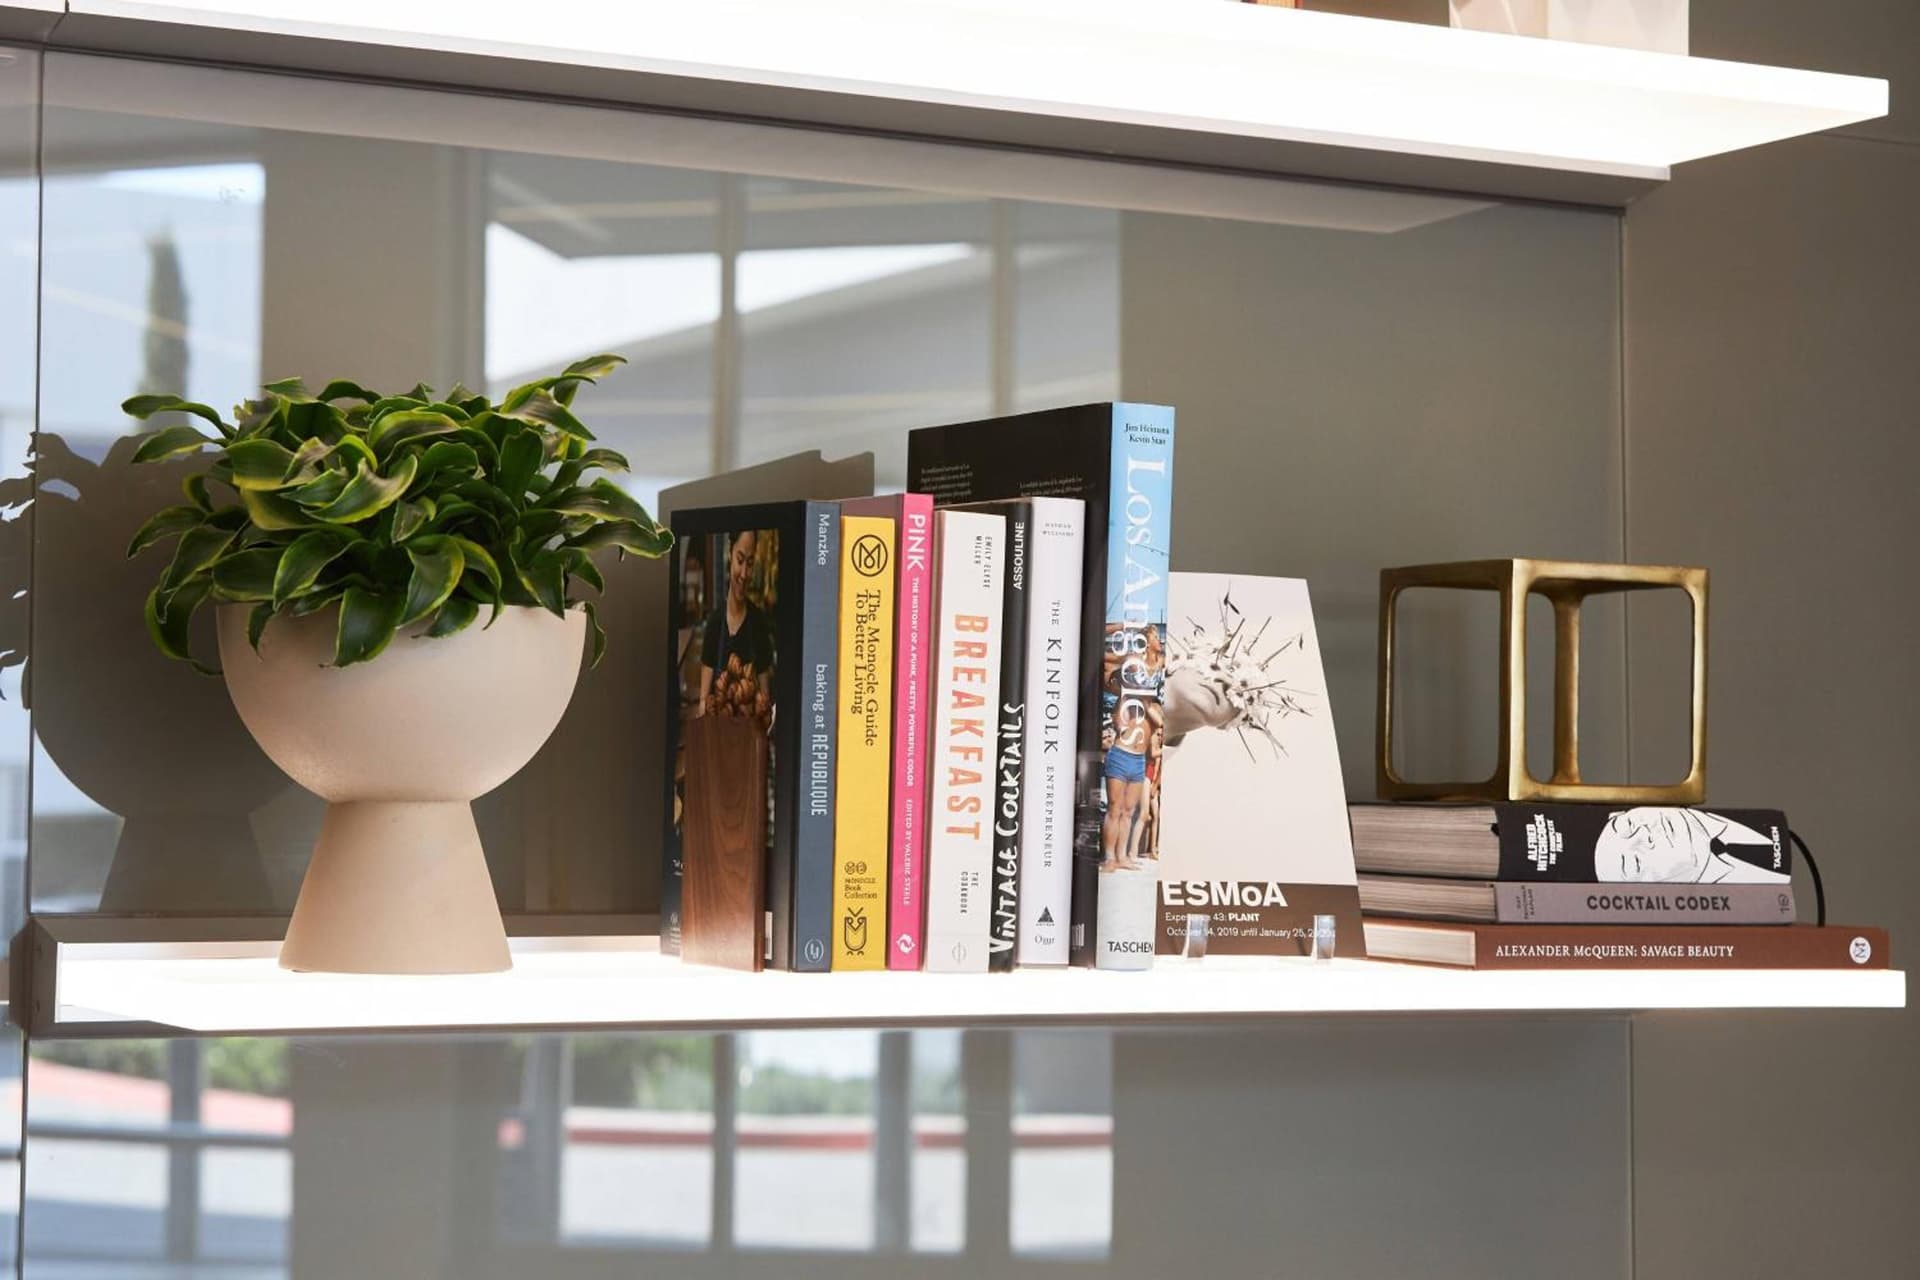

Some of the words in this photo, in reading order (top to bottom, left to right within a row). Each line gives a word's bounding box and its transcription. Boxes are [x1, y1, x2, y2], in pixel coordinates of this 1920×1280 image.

[1129, 435, 1150, 443] Kevin
[1126, 456, 1165, 545] Los
[818, 514, 830, 566] Manzke
[907, 514, 926, 570] PINK
[1013, 522, 1024, 590] ASSOULINE
[857, 589, 868, 609] To
[868, 590, 881, 621] The
[911, 595, 919, 630] HISTORY
[1052, 601, 1060, 625] THE
[855, 613, 868, 657] Better
[911, 633, 918, 644] OF
[1112, 551, 1161, 746] Angeles
[866, 623, 881, 694] Monocle
[813, 664, 828, 710] baking
[851, 660, 867, 715] Living
[1044, 639, 1061, 753] KINFOLK
[815, 715, 825, 728] at
[865, 699, 879, 746] Guide
[907, 714, 915, 757] POWERFUL
[946, 614, 989, 840] BREAKFAST
[905, 799, 913, 828] EDITED
[1044, 766, 1055, 868] ENTREPRENEUR
[904, 831, 912, 841] BY
[1526, 824, 1537, 861] ALFRED
[1534, 814, 1547, 871] HITCHCOCK
[1771, 826, 1781, 868] TASCHEN
[1161, 881, 1288, 907] ESMoA
[1587, 895, 1671, 911] COCKTAIL
[1675, 896, 1731, 911] CODEX
[1213, 912, 1227, 922] 43:
[1229, 913, 1260, 921] PLANT
[1217, 927, 1239, 937] 2019
[1240, 927, 1258, 937] until
[1259, 928, 1291, 940] January
[1107, 941, 1153, 953] TASCHEN
[1496, 945, 1569, 957] ALEXANDER
[1641, 945, 1685, 957] SAVAGE
[1688, 945, 1734, 957] BEAUTY
